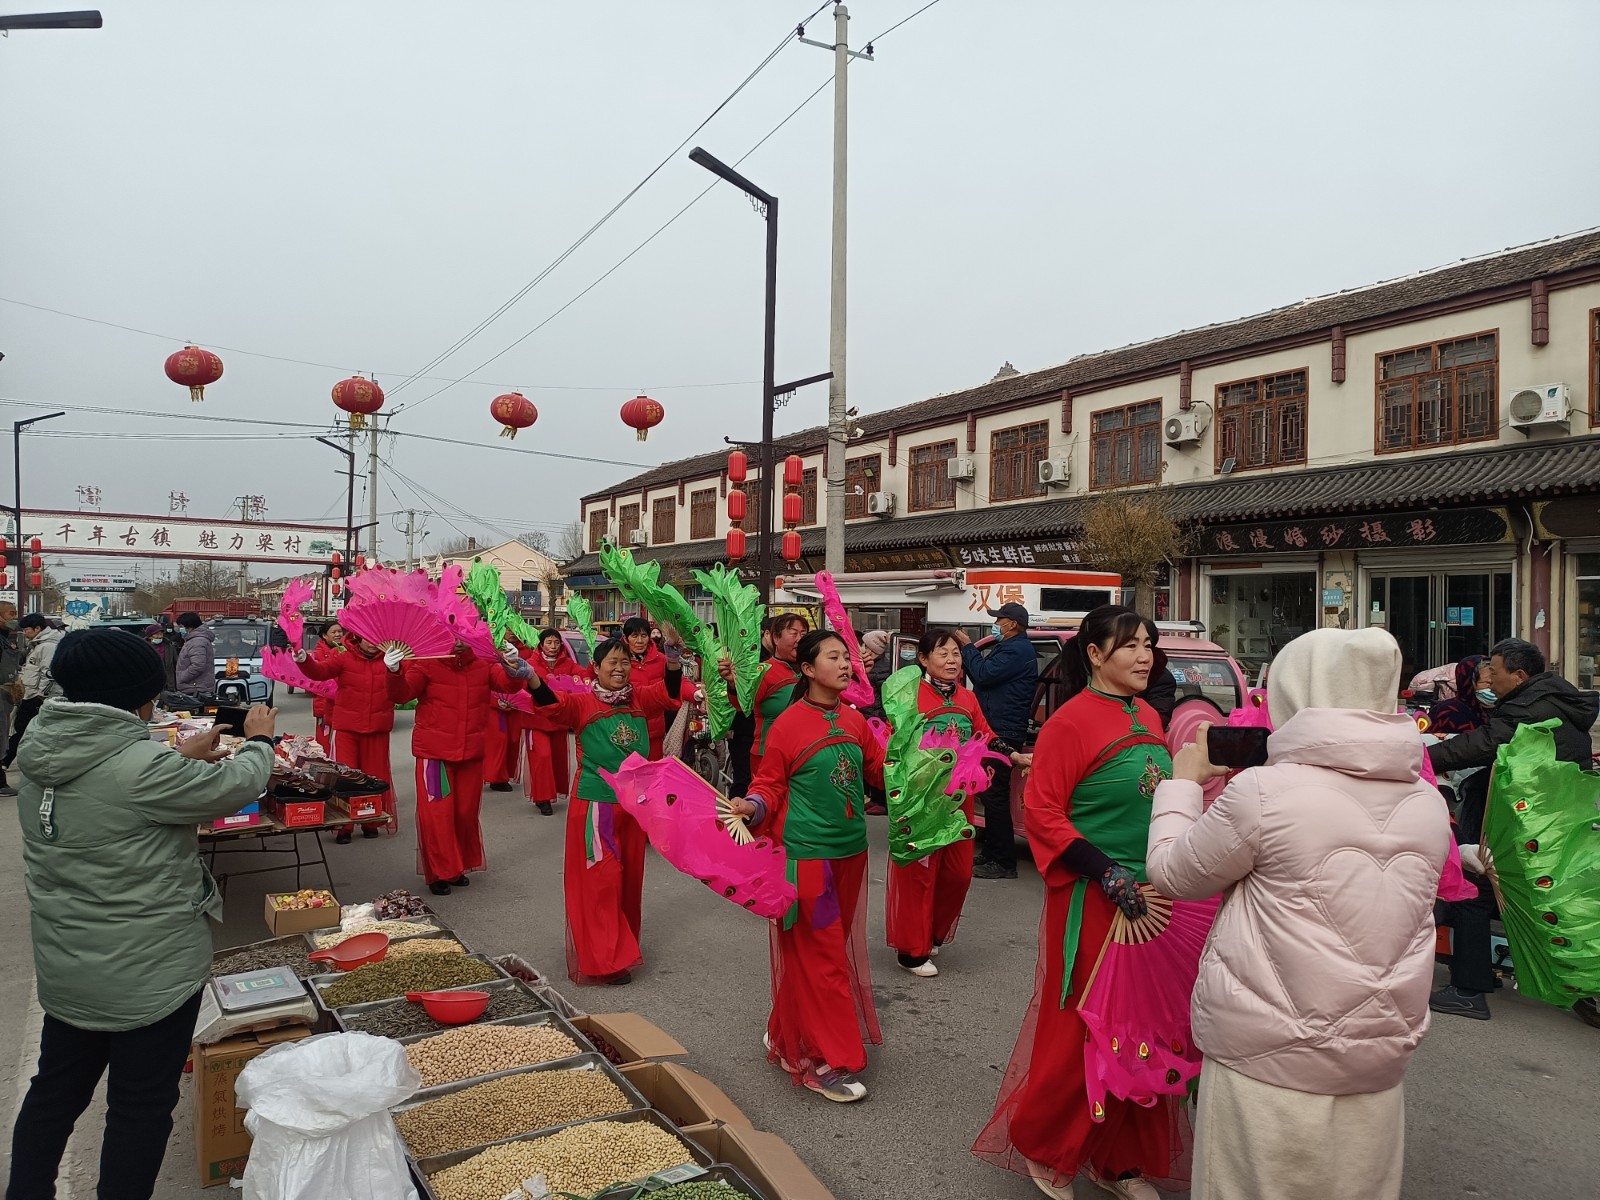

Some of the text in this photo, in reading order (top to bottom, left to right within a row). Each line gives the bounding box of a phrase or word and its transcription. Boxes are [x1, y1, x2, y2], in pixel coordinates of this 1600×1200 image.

[56, 523, 302, 553] 千年古镇 魅力梁村
[1215, 518, 1437, 551] 浪漫婚纱摄影
[960, 545, 1036, 565] 乡味生鲜店
[1062, 554, 1081, 563] 电话
